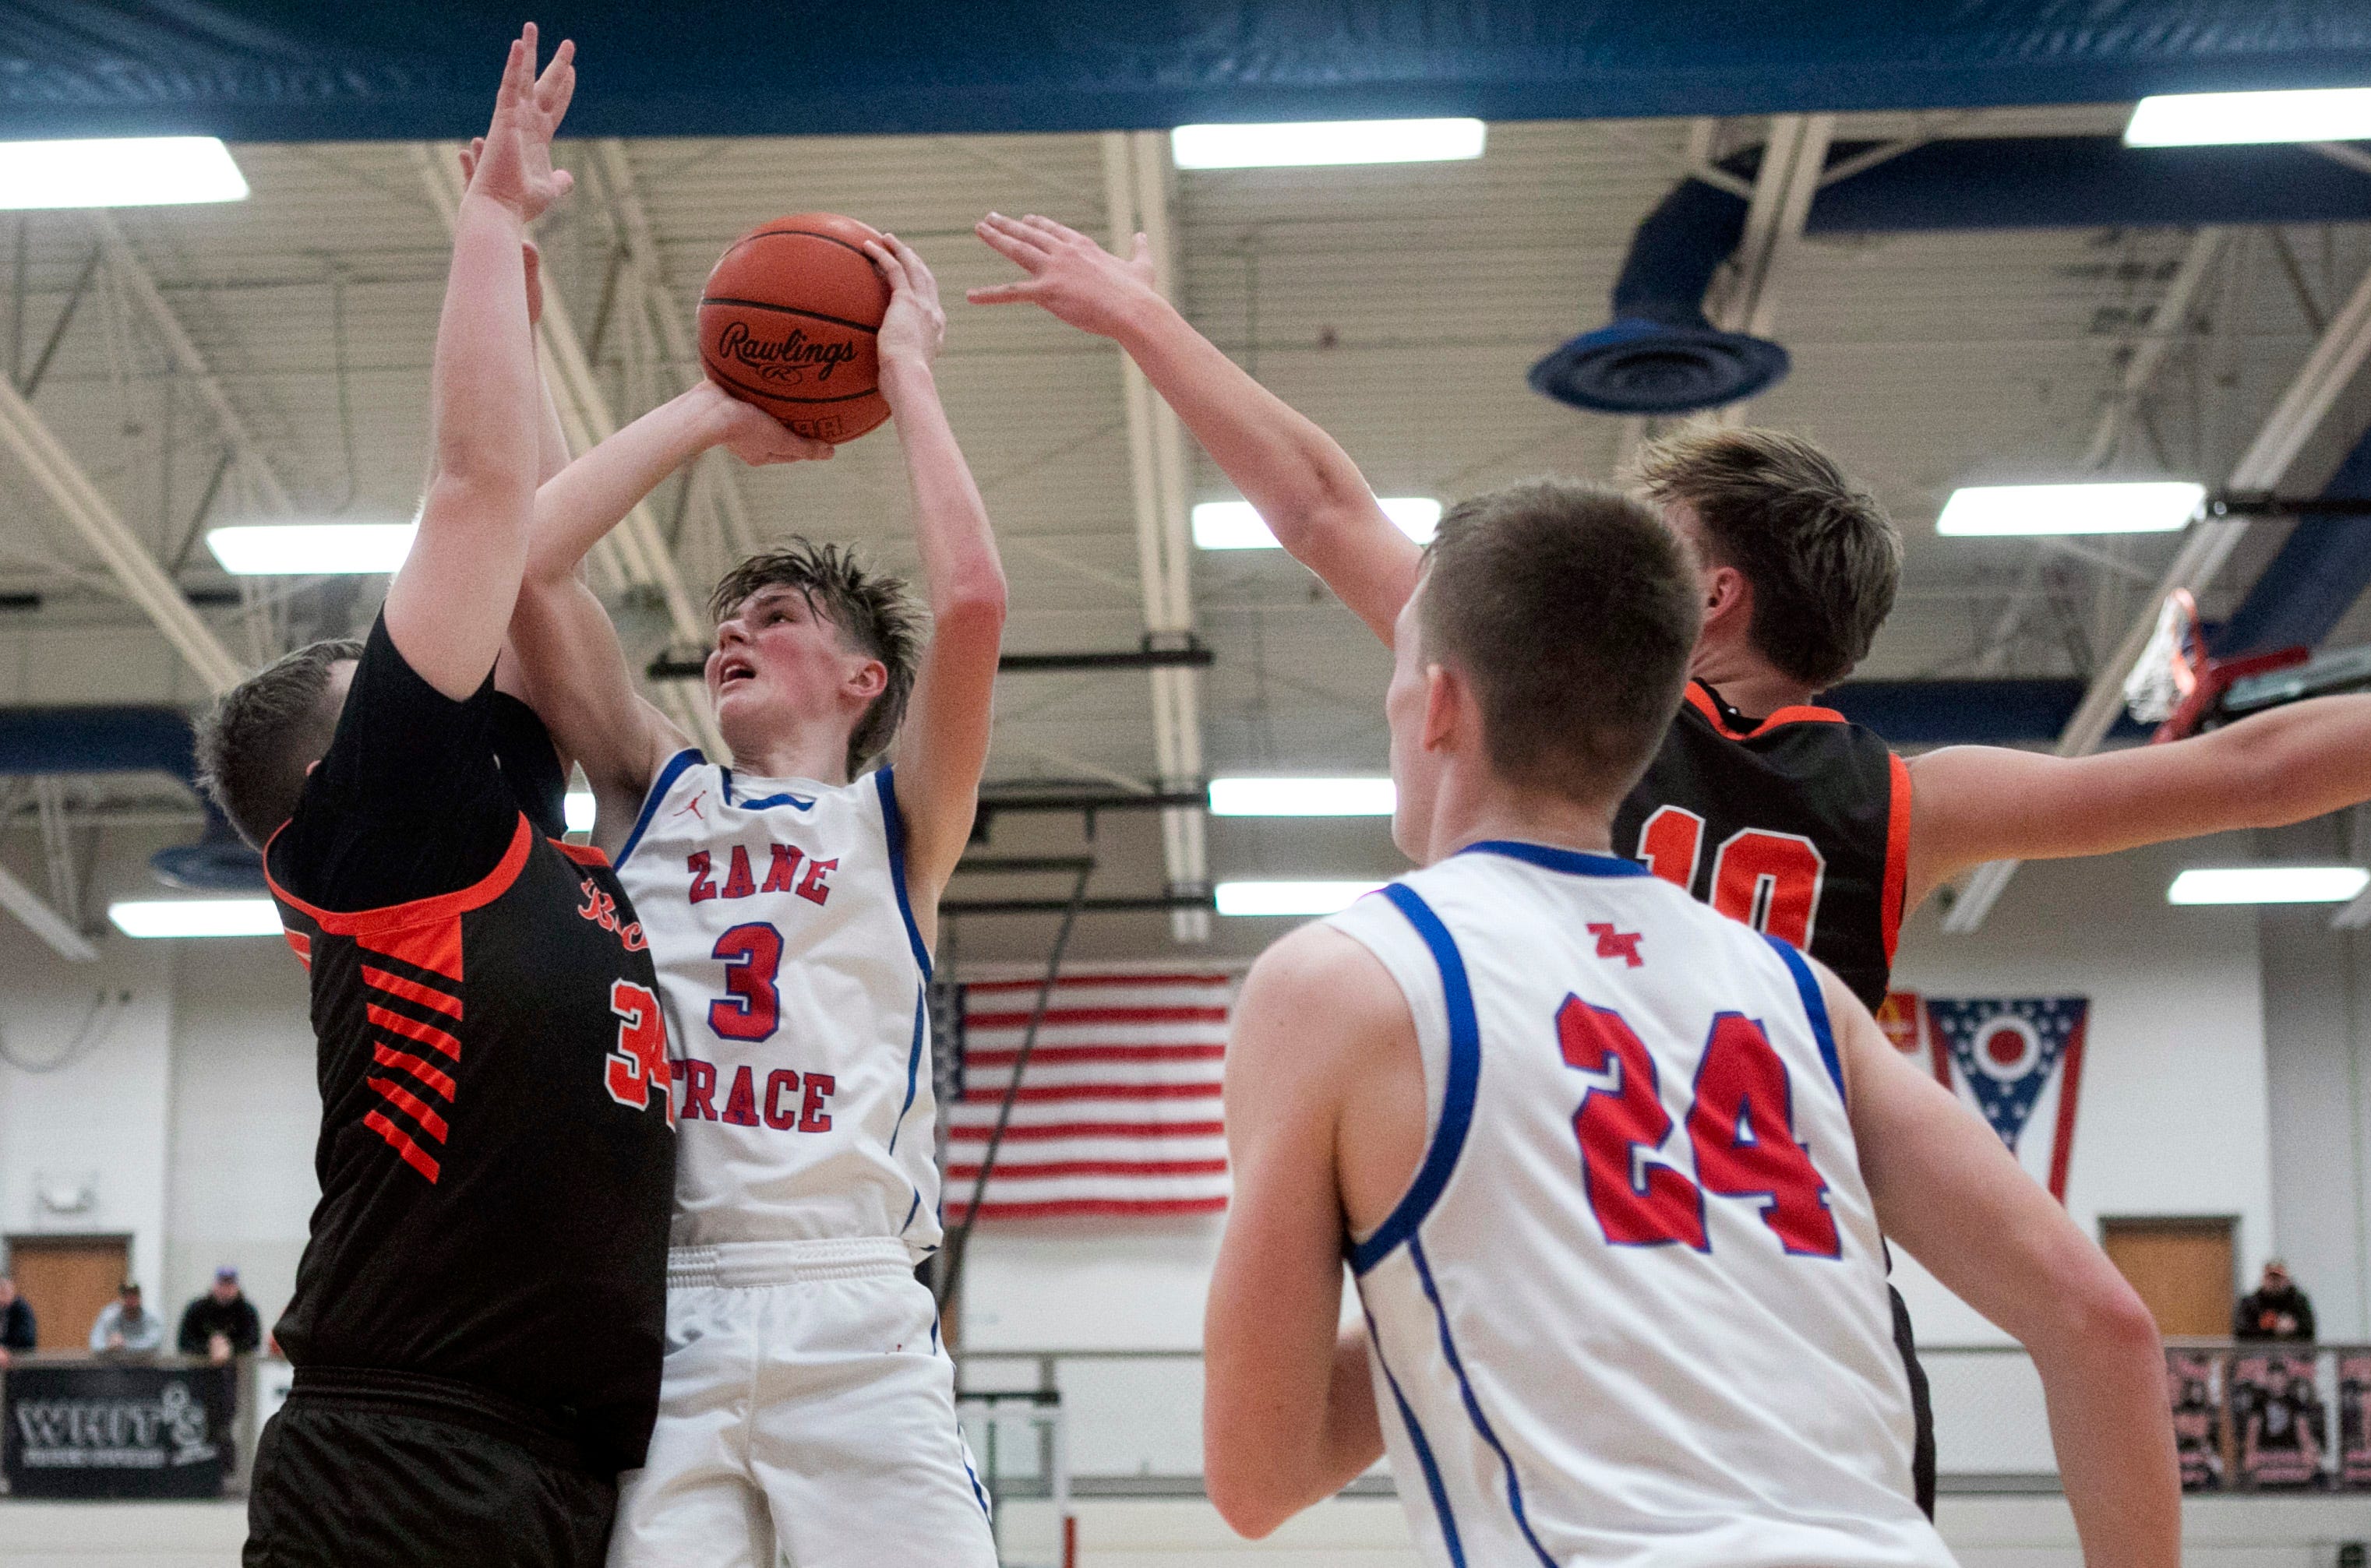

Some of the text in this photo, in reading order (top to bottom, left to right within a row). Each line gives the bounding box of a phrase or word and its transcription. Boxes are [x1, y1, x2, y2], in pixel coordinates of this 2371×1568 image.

[719, 321, 858, 382] Rawlings
[687, 843, 840, 907] ZANE
[1635, 804, 1827, 953] 10
[707, 921, 785, 1044] 3
[1555, 991, 1842, 1260] 24
